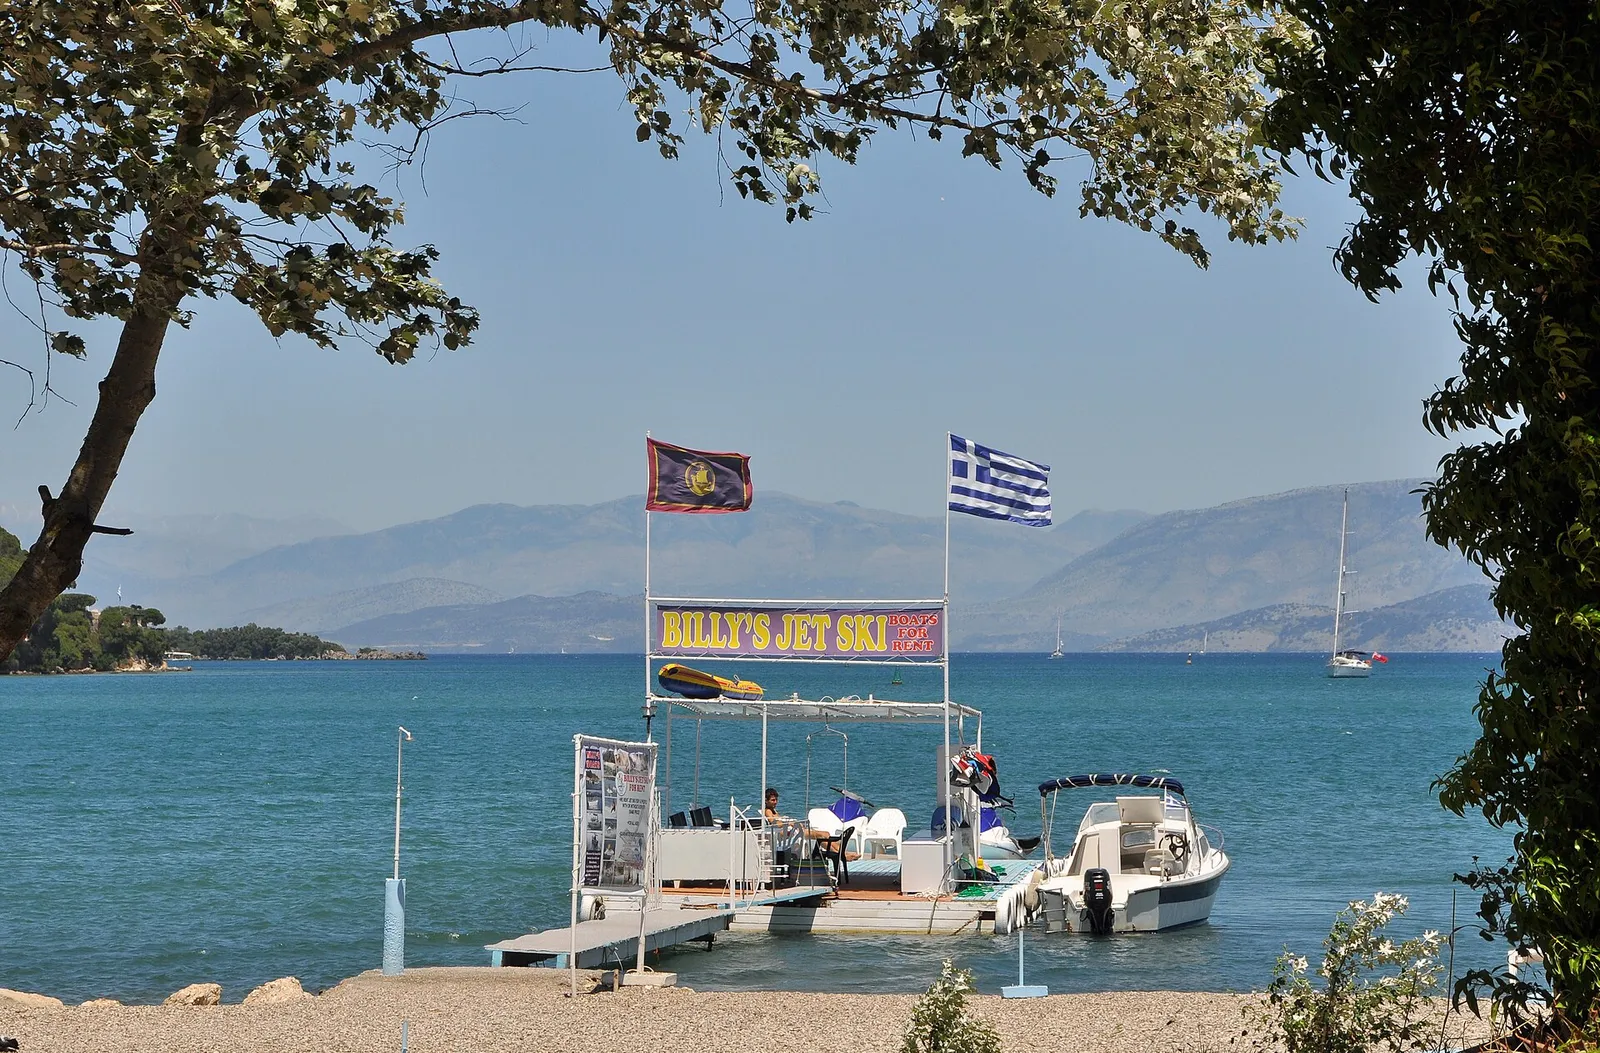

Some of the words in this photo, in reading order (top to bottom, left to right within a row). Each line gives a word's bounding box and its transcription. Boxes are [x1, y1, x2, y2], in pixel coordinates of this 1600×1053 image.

[889, 615, 937, 625] BOATS
[662, 612, 770, 649] BILLY'S
[776, 614, 830, 650] JET
[837, 615, 887, 651] SKI
[898, 628, 928, 638] FOR
[892, 641, 933, 651] RENT
